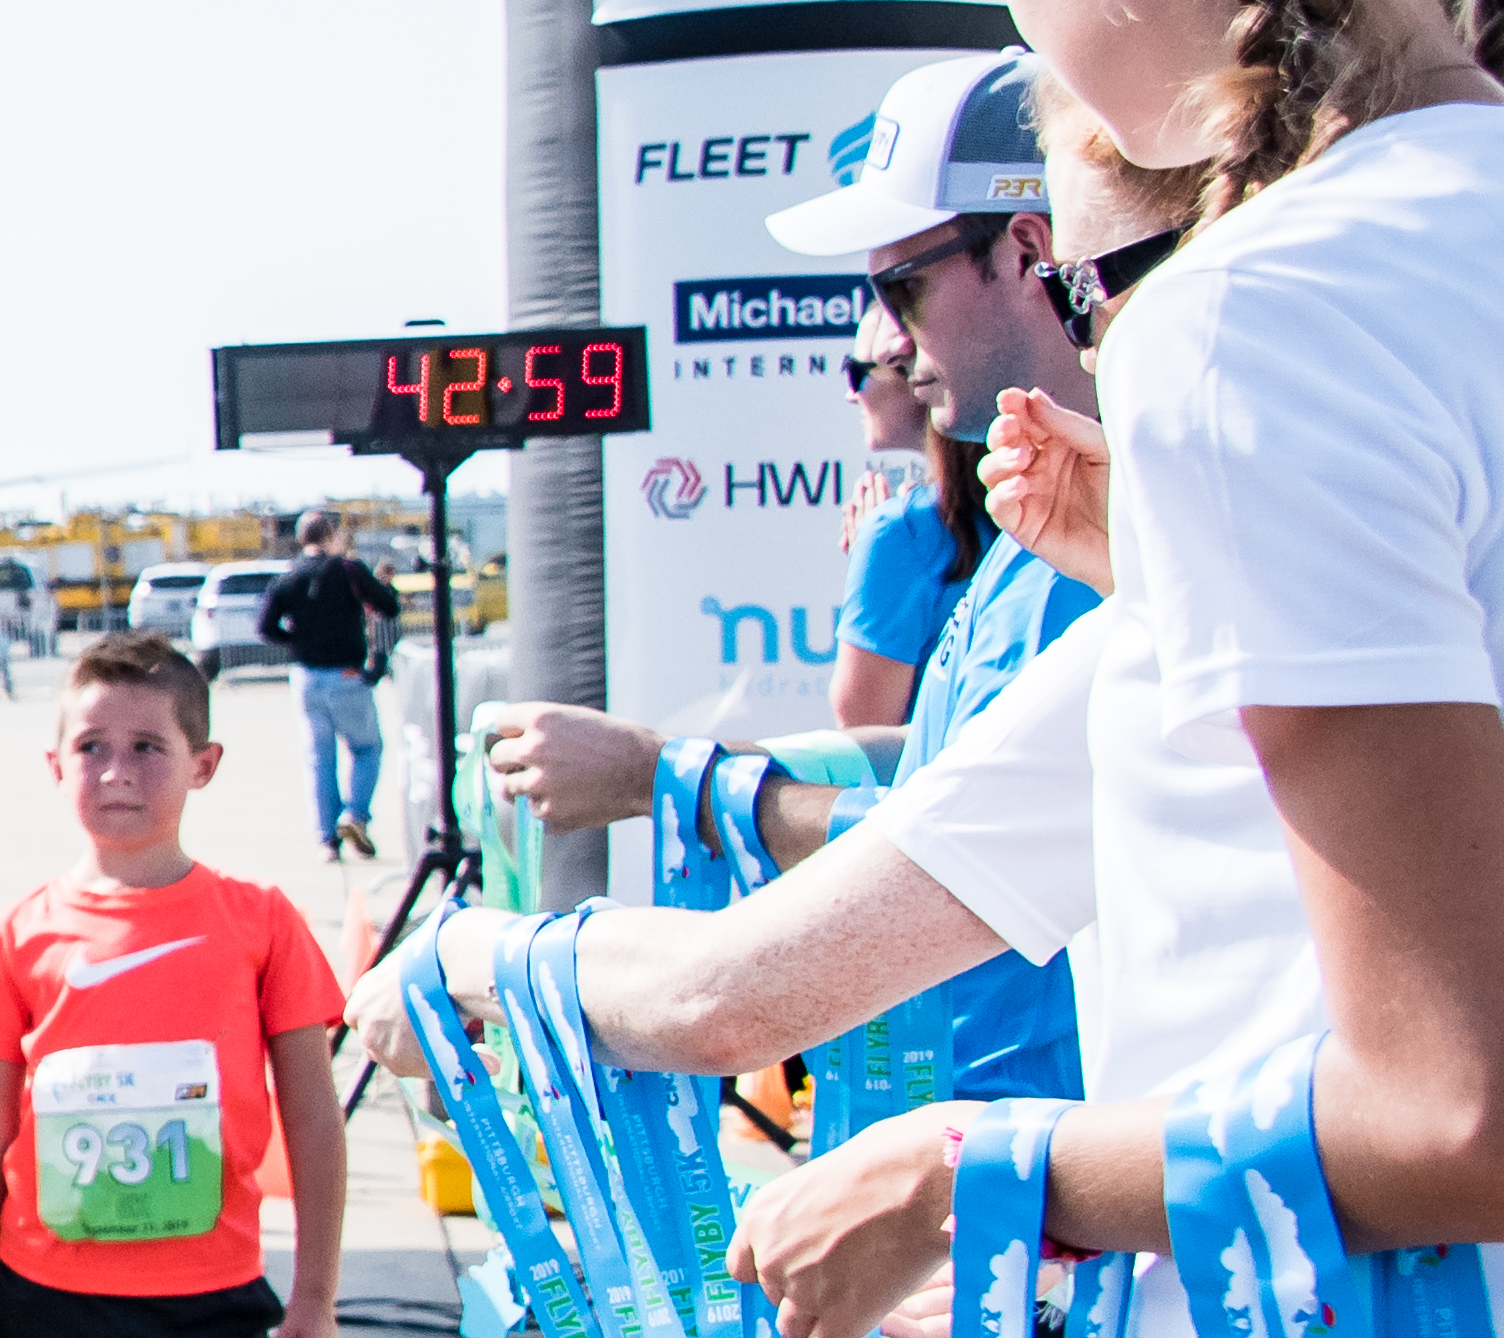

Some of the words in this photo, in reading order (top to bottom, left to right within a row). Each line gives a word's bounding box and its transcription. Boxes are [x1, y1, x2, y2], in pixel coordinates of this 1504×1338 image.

[635, 132, 810, 184] FLEET
[689, 288, 864, 332] Michael
[724, 461, 843, 508] HWI
[903, 1050, 934, 1064] 2019
[62, 1118, 190, 1189] 931
[674, 1146, 713, 1196] 5K
[661, 1268, 686, 1286] 201
[689, 1203, 739, 1304] FLYBY
[706, 1305, 740, 1324] 2019
